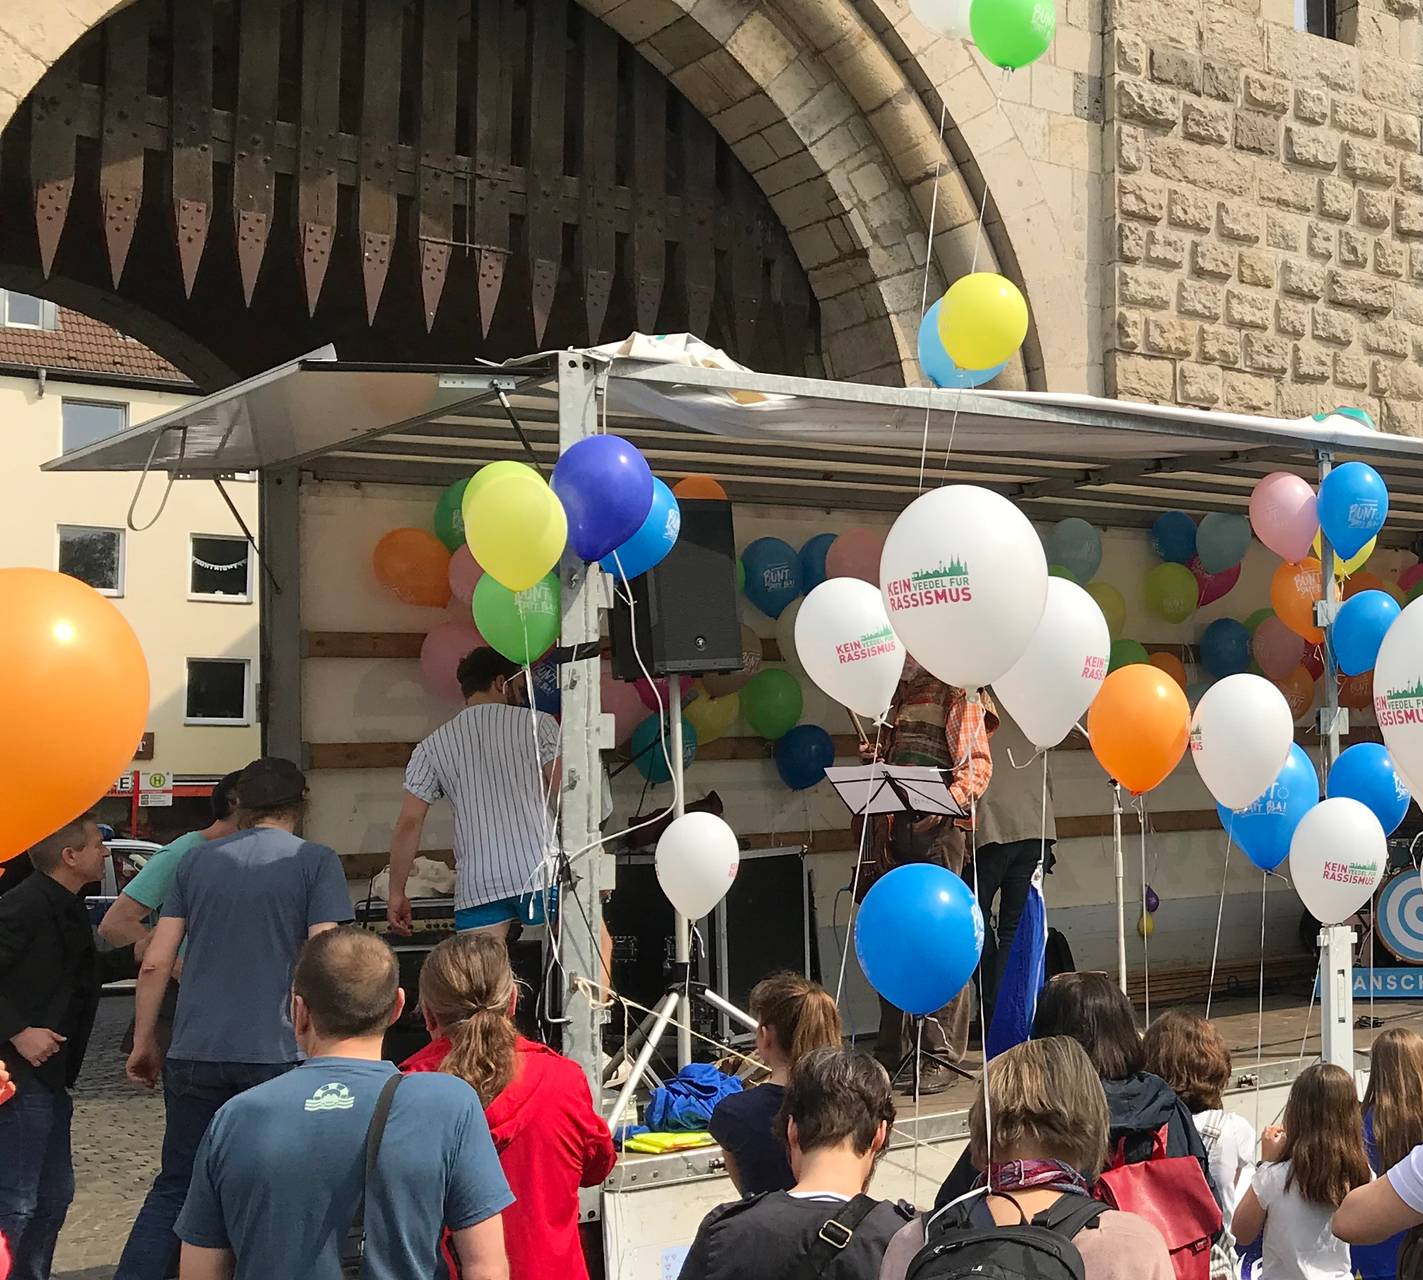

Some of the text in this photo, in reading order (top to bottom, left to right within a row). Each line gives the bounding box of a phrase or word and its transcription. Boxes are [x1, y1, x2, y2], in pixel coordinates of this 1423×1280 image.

[887, 578, 912, 597] KEIN
[911, 579, 947, 592] VEEDEL
[889, 587, 972, 612] RASSISMUS
[835, 640, 861, 654] KEIN
[838, 640, 896, 664] RASSISMUS
[1324, 861, 1348, 873] KEIN
[1323, 870, 1375, 885] RASSISMUS
